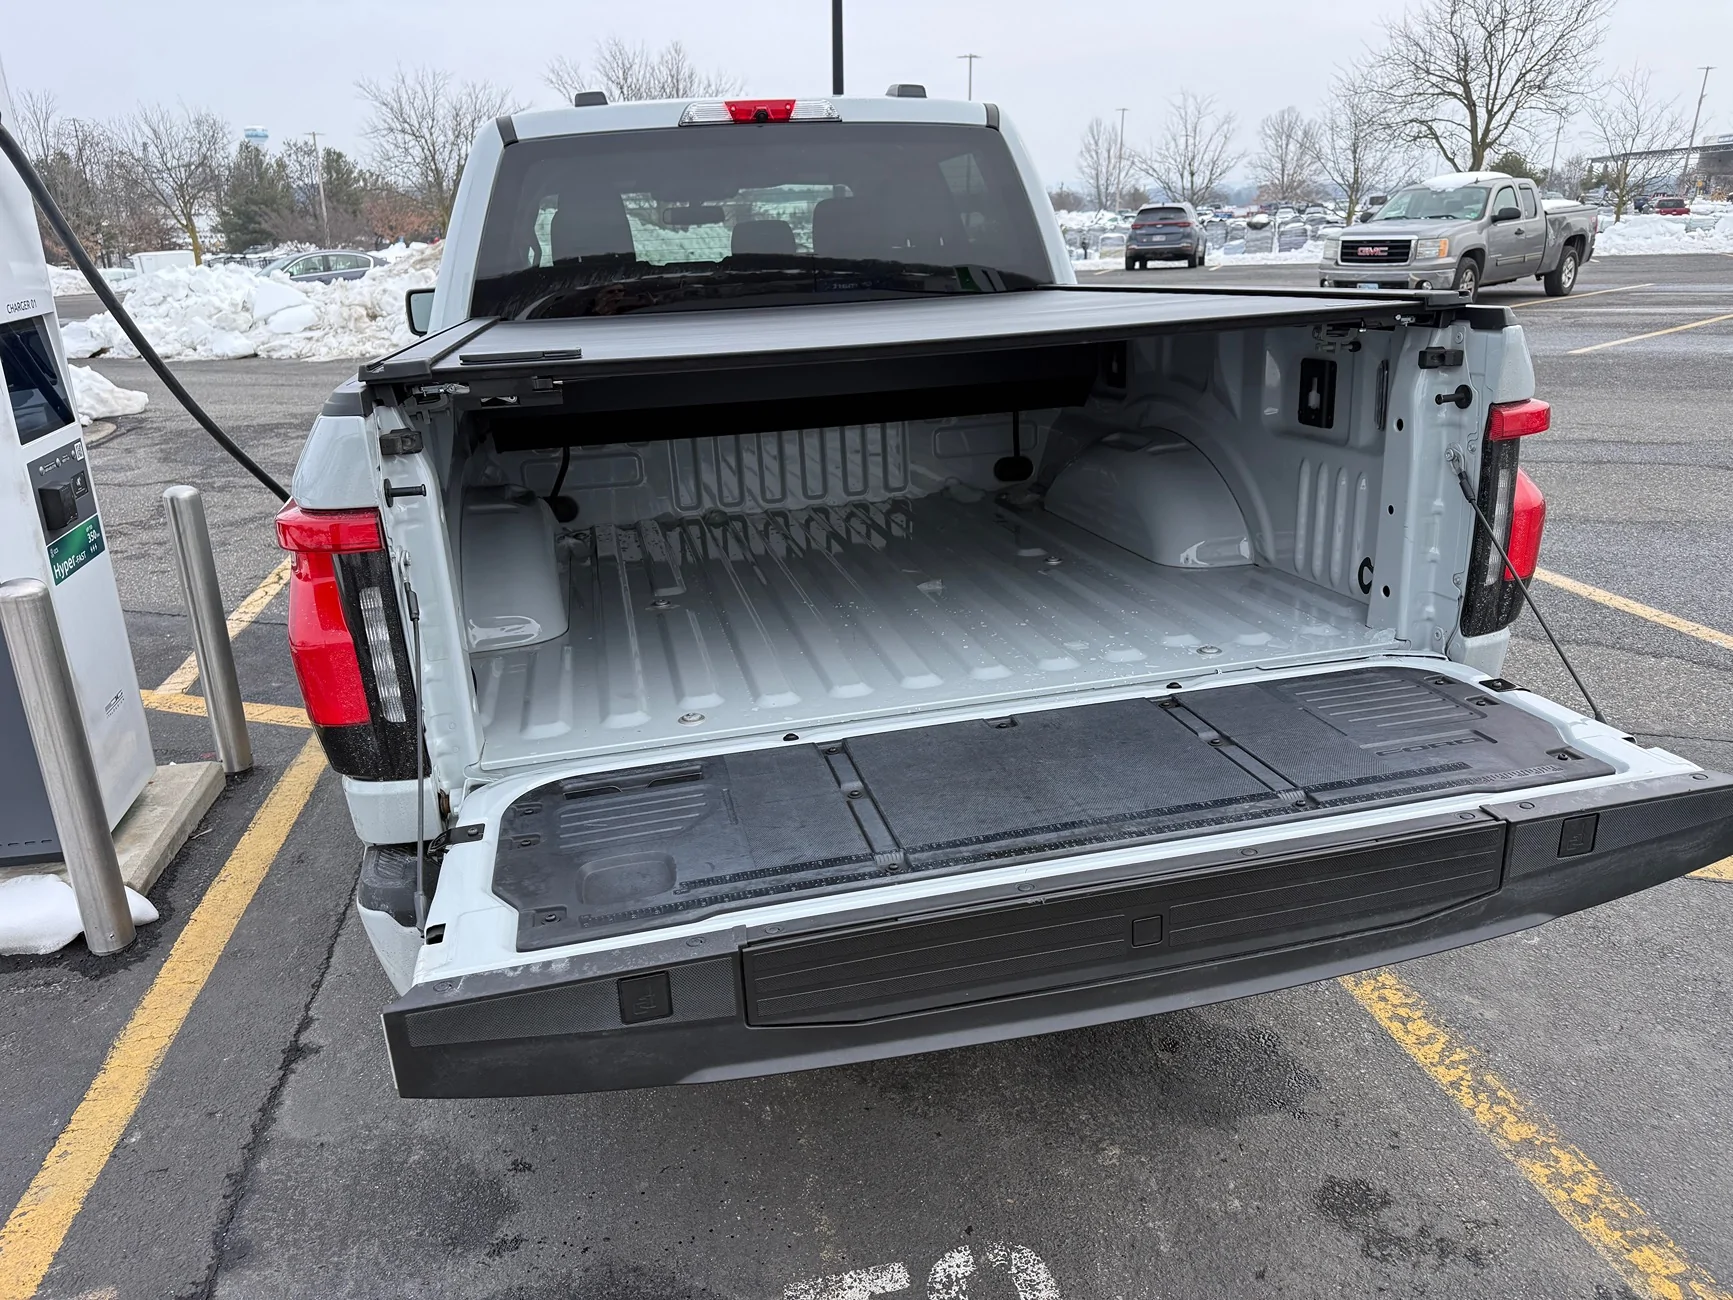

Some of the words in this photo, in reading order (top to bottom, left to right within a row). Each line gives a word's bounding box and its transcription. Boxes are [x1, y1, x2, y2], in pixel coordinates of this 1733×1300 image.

[1357, 246, 1389, 256] GMC
[6, 300, 31, 314] CHARGER
[30, 299, 37, 309] 01
[87, 529, 97, 543] 350
